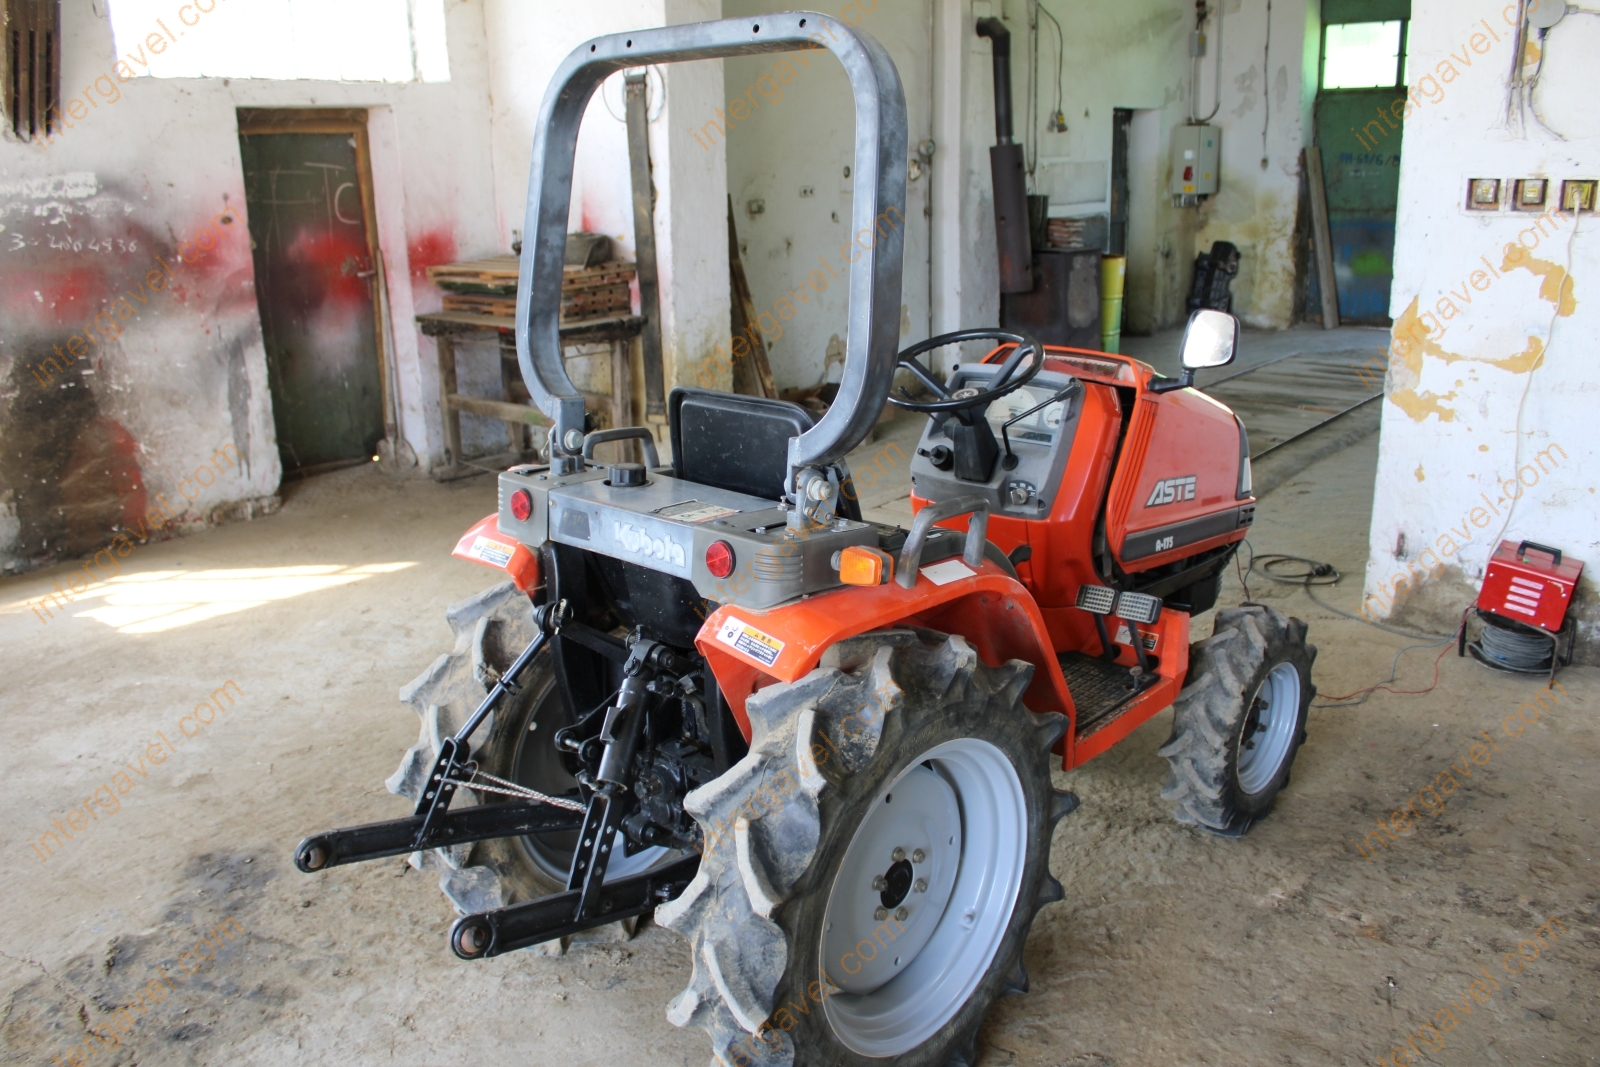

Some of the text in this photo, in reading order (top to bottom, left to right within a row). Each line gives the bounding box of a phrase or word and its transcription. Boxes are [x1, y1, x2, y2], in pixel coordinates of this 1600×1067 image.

[1144, 474, 1197, 508] ASTE
[614, 520, 687, 568] Kubota
[1156, 536, 1174, 552] A-175
